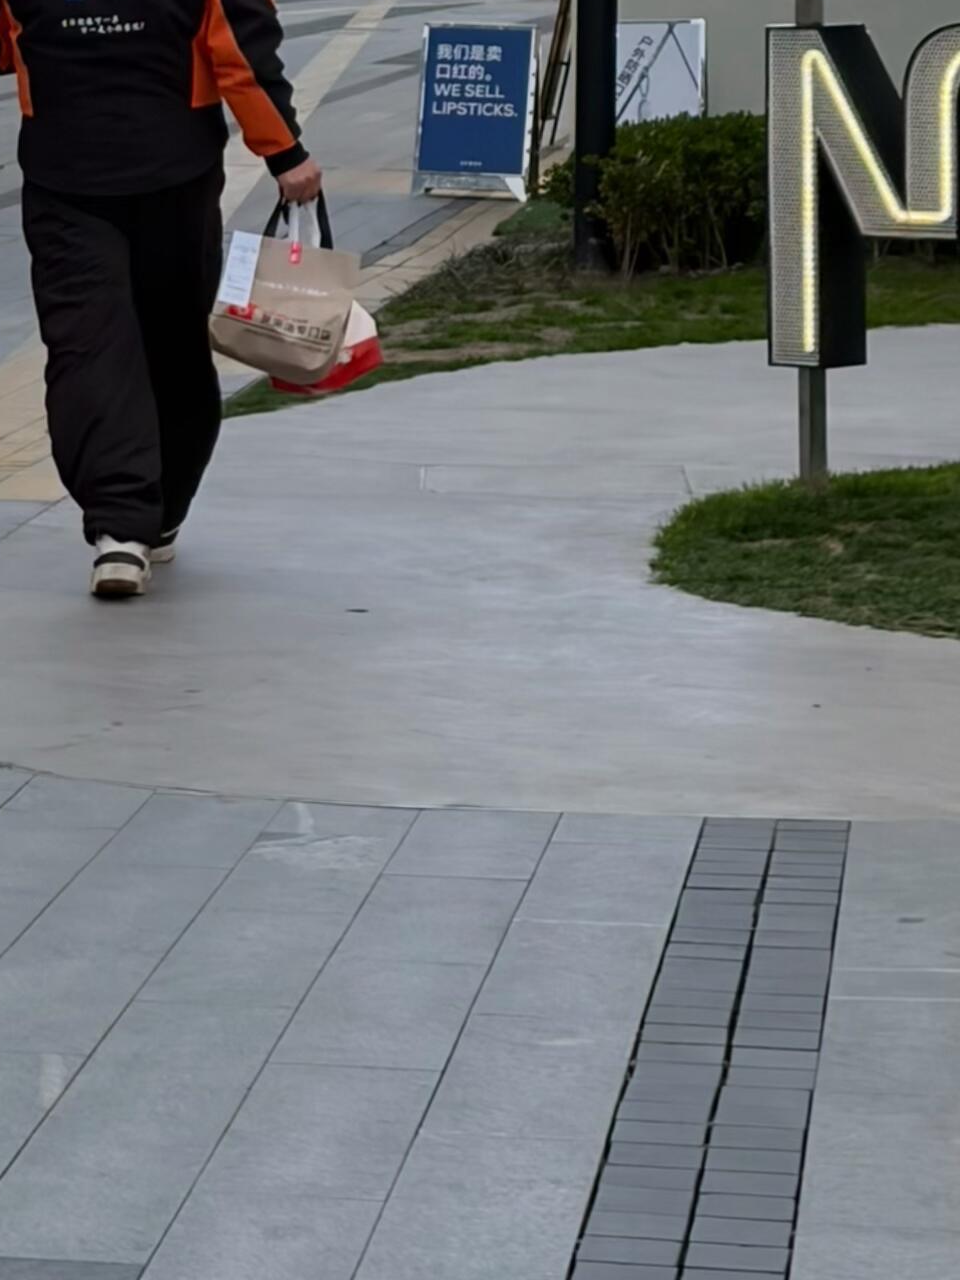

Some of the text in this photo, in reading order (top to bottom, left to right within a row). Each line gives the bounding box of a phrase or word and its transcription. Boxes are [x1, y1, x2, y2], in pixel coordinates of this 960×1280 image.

[437, 43, 503, 62] 我们是卖
[433, 83, 505, 98] WE SELL
[432, 101, 519, 118] LIPSTICKS.
